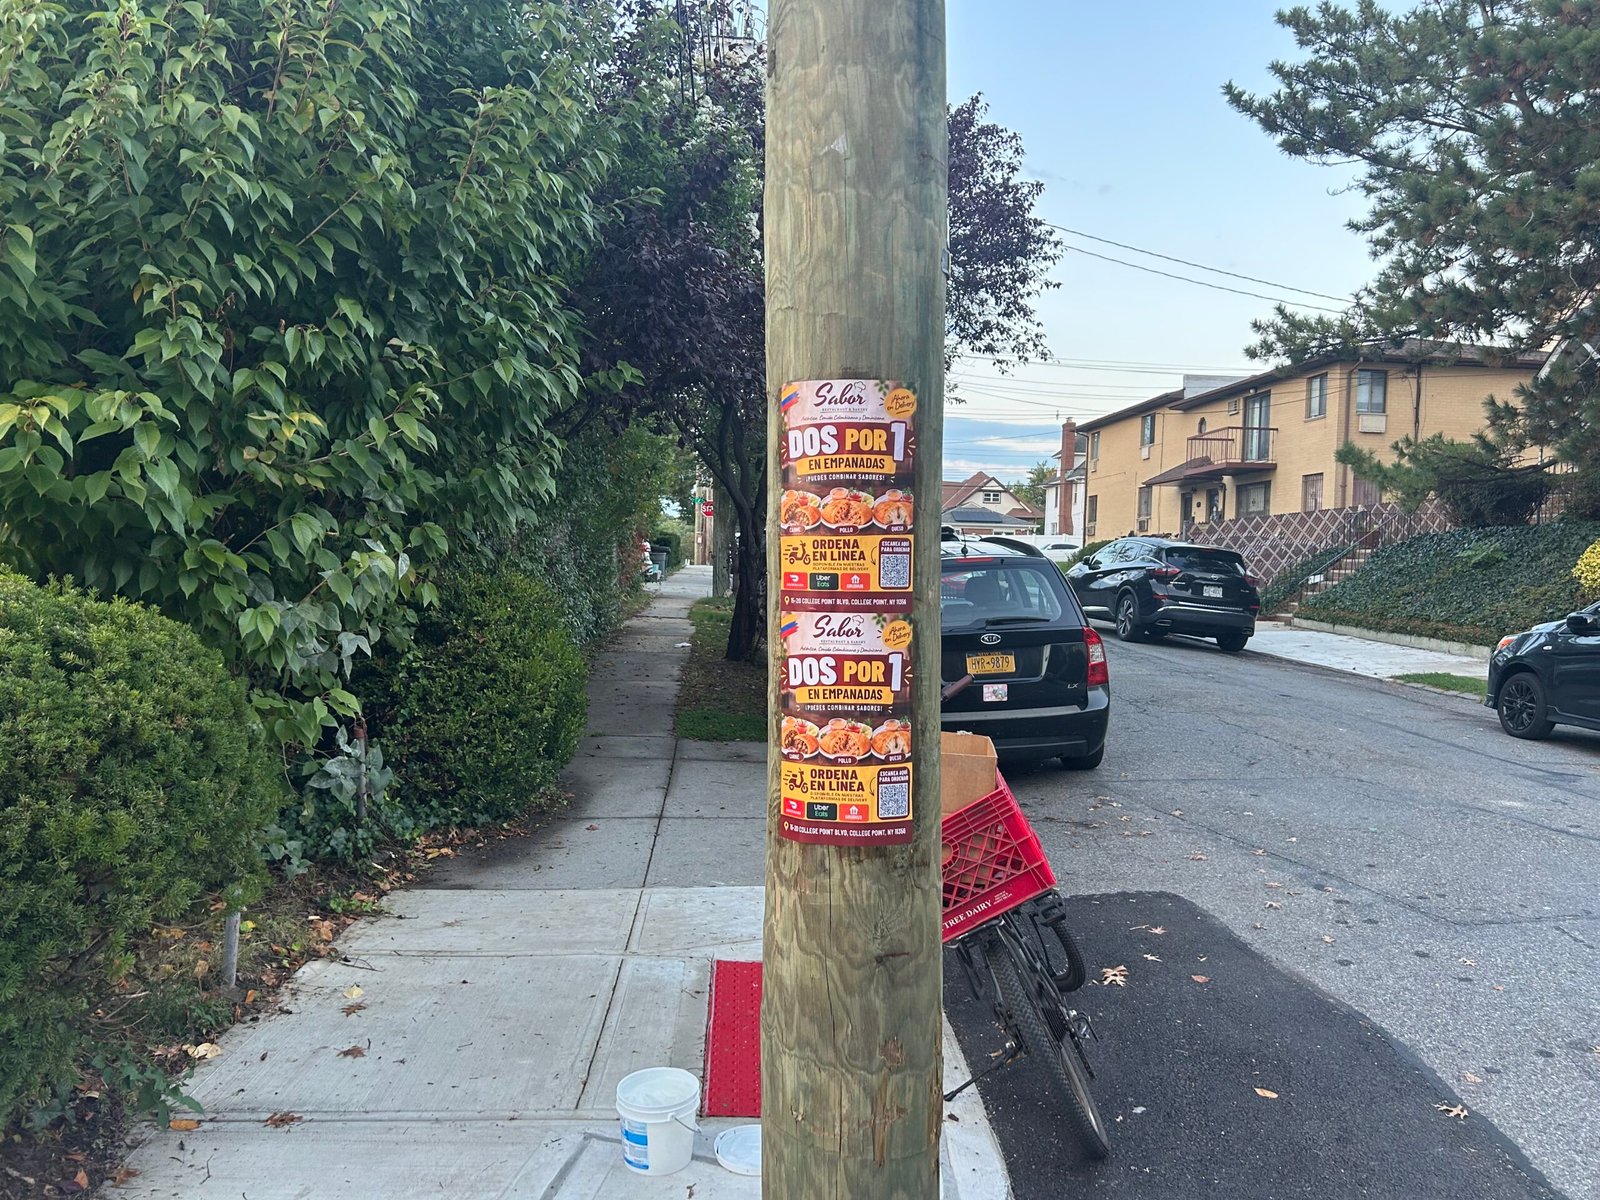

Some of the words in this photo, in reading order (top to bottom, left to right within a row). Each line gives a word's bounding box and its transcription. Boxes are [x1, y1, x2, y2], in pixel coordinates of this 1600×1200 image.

[814, 382, 866, 407] Sabor
[895, 400, 915, 411] Delivery
[788, 425, 839, 459] DOS
[845, 428, 887, 451] POR
[891, 422, 906, 460] 1
[808, 458, 820, 470] EN
[824, 457, 885, 469] EMPANADAS
[812, 539, 860, 550] ORDENA
[812, 551, 828, 561] EN
[813, 615, 864, 638] Sabor
[892, 631, 912, 642] Delivery
[788, 656, 837, 686] DOS
[844, 661, 885, 682] POR
[888, 653, 902, 691] 1
[808, 689, 820, 700] EN
[823, 689, 882, 700] EMPANADAS
[810, 768, 858, 780] ORDENA
[810, 781, 825, 791] EN
[799, 826, 818, 834] COLLEGE
[943, 912, 966, 929] TREE
[966, 900, 992, 917] DAIRY
